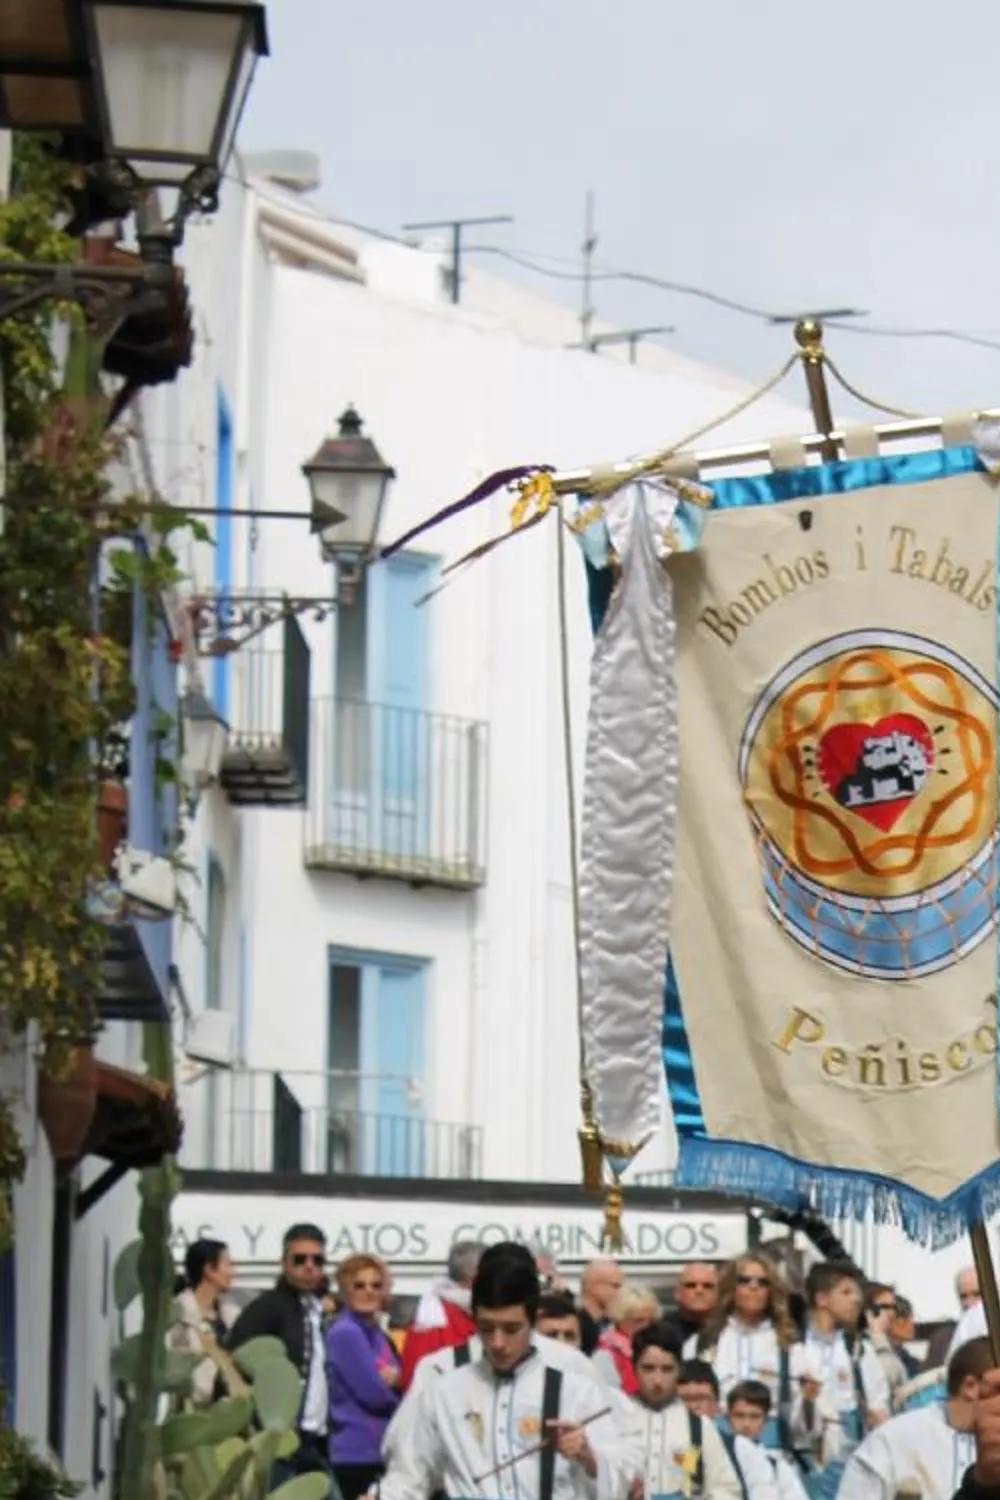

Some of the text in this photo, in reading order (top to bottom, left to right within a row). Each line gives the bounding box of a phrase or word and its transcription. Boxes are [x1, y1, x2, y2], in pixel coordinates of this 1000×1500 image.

[699, 524, 998, 647] Bombos i Tabals
[771, 993, 998, 1086] Peñisco
[241, 1224, 264, 1256] Y
[326, 1224, 428, 1256] ATOS
